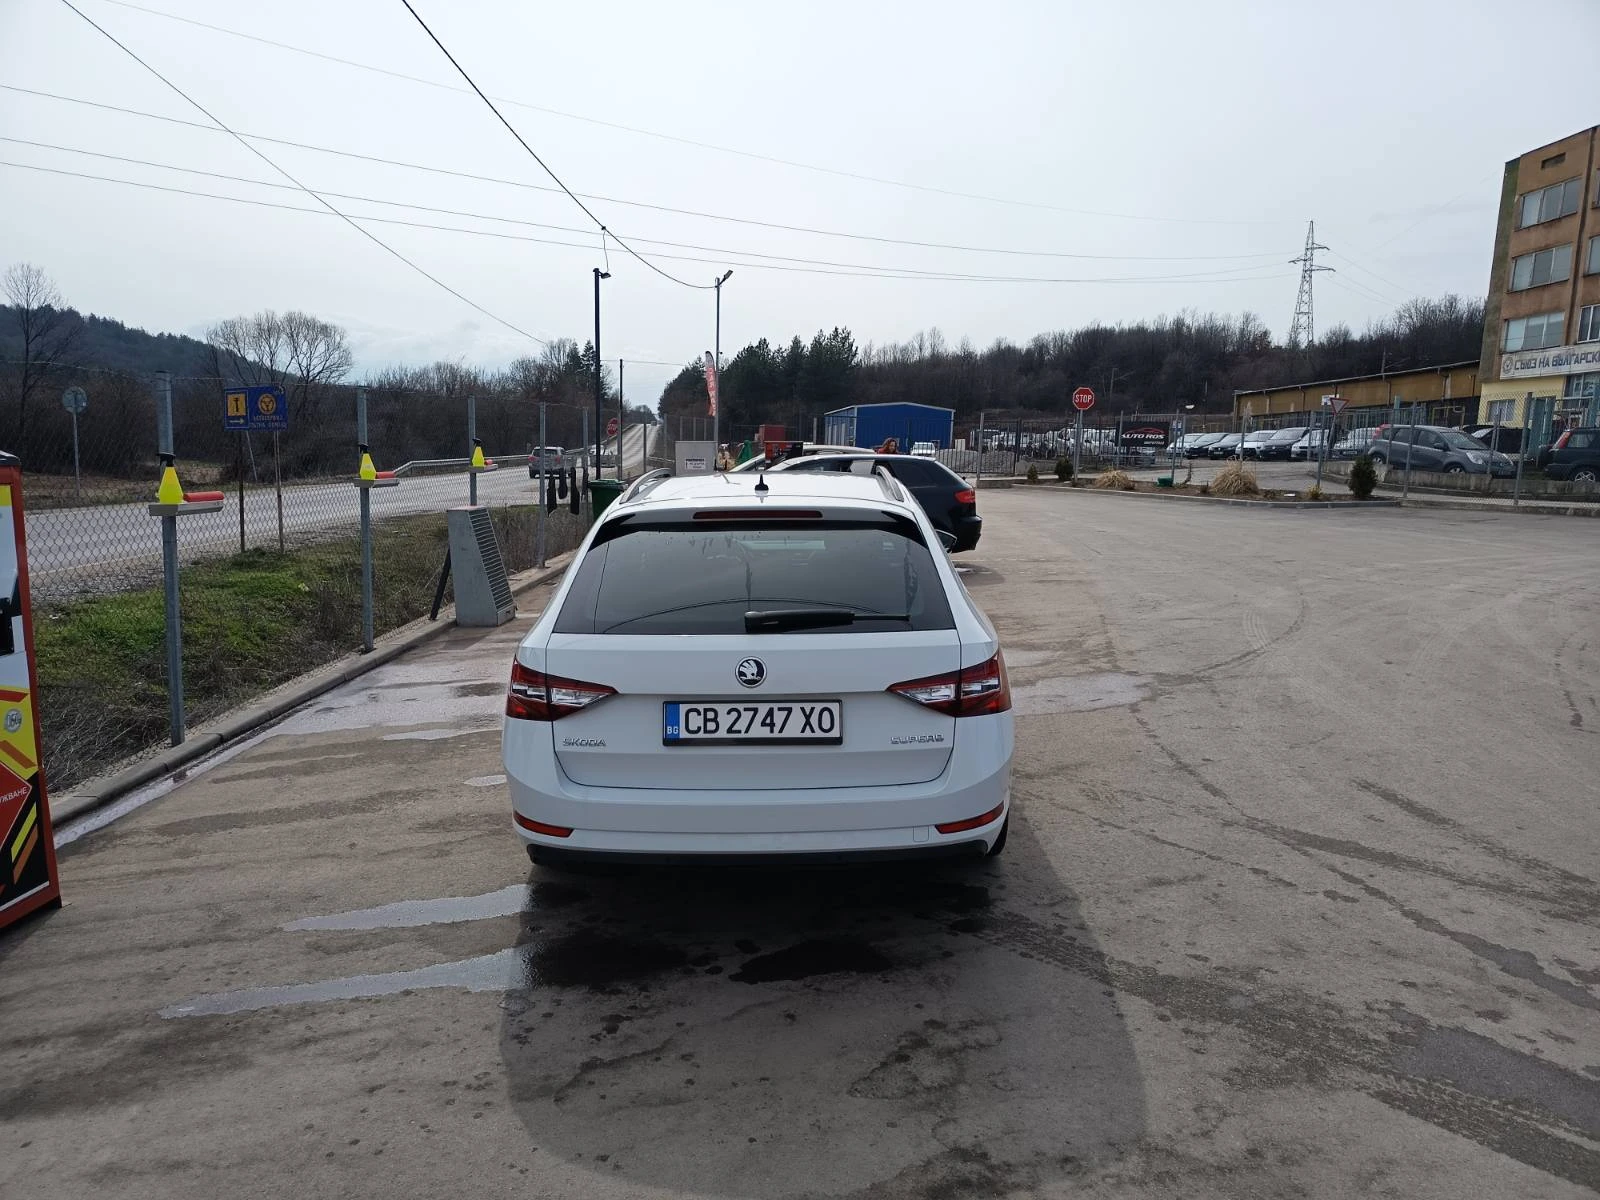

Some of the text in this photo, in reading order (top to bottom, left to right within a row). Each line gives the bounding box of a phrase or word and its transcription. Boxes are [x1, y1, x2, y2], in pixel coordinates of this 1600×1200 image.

[1539, 357, 1550, 368] НА
[1552, 351, 1600, 366] БЪЛГАРСК
[1075, 394, 1092, 403] STOP
[667, 706, 835, 735] BG CB 2747 XO
